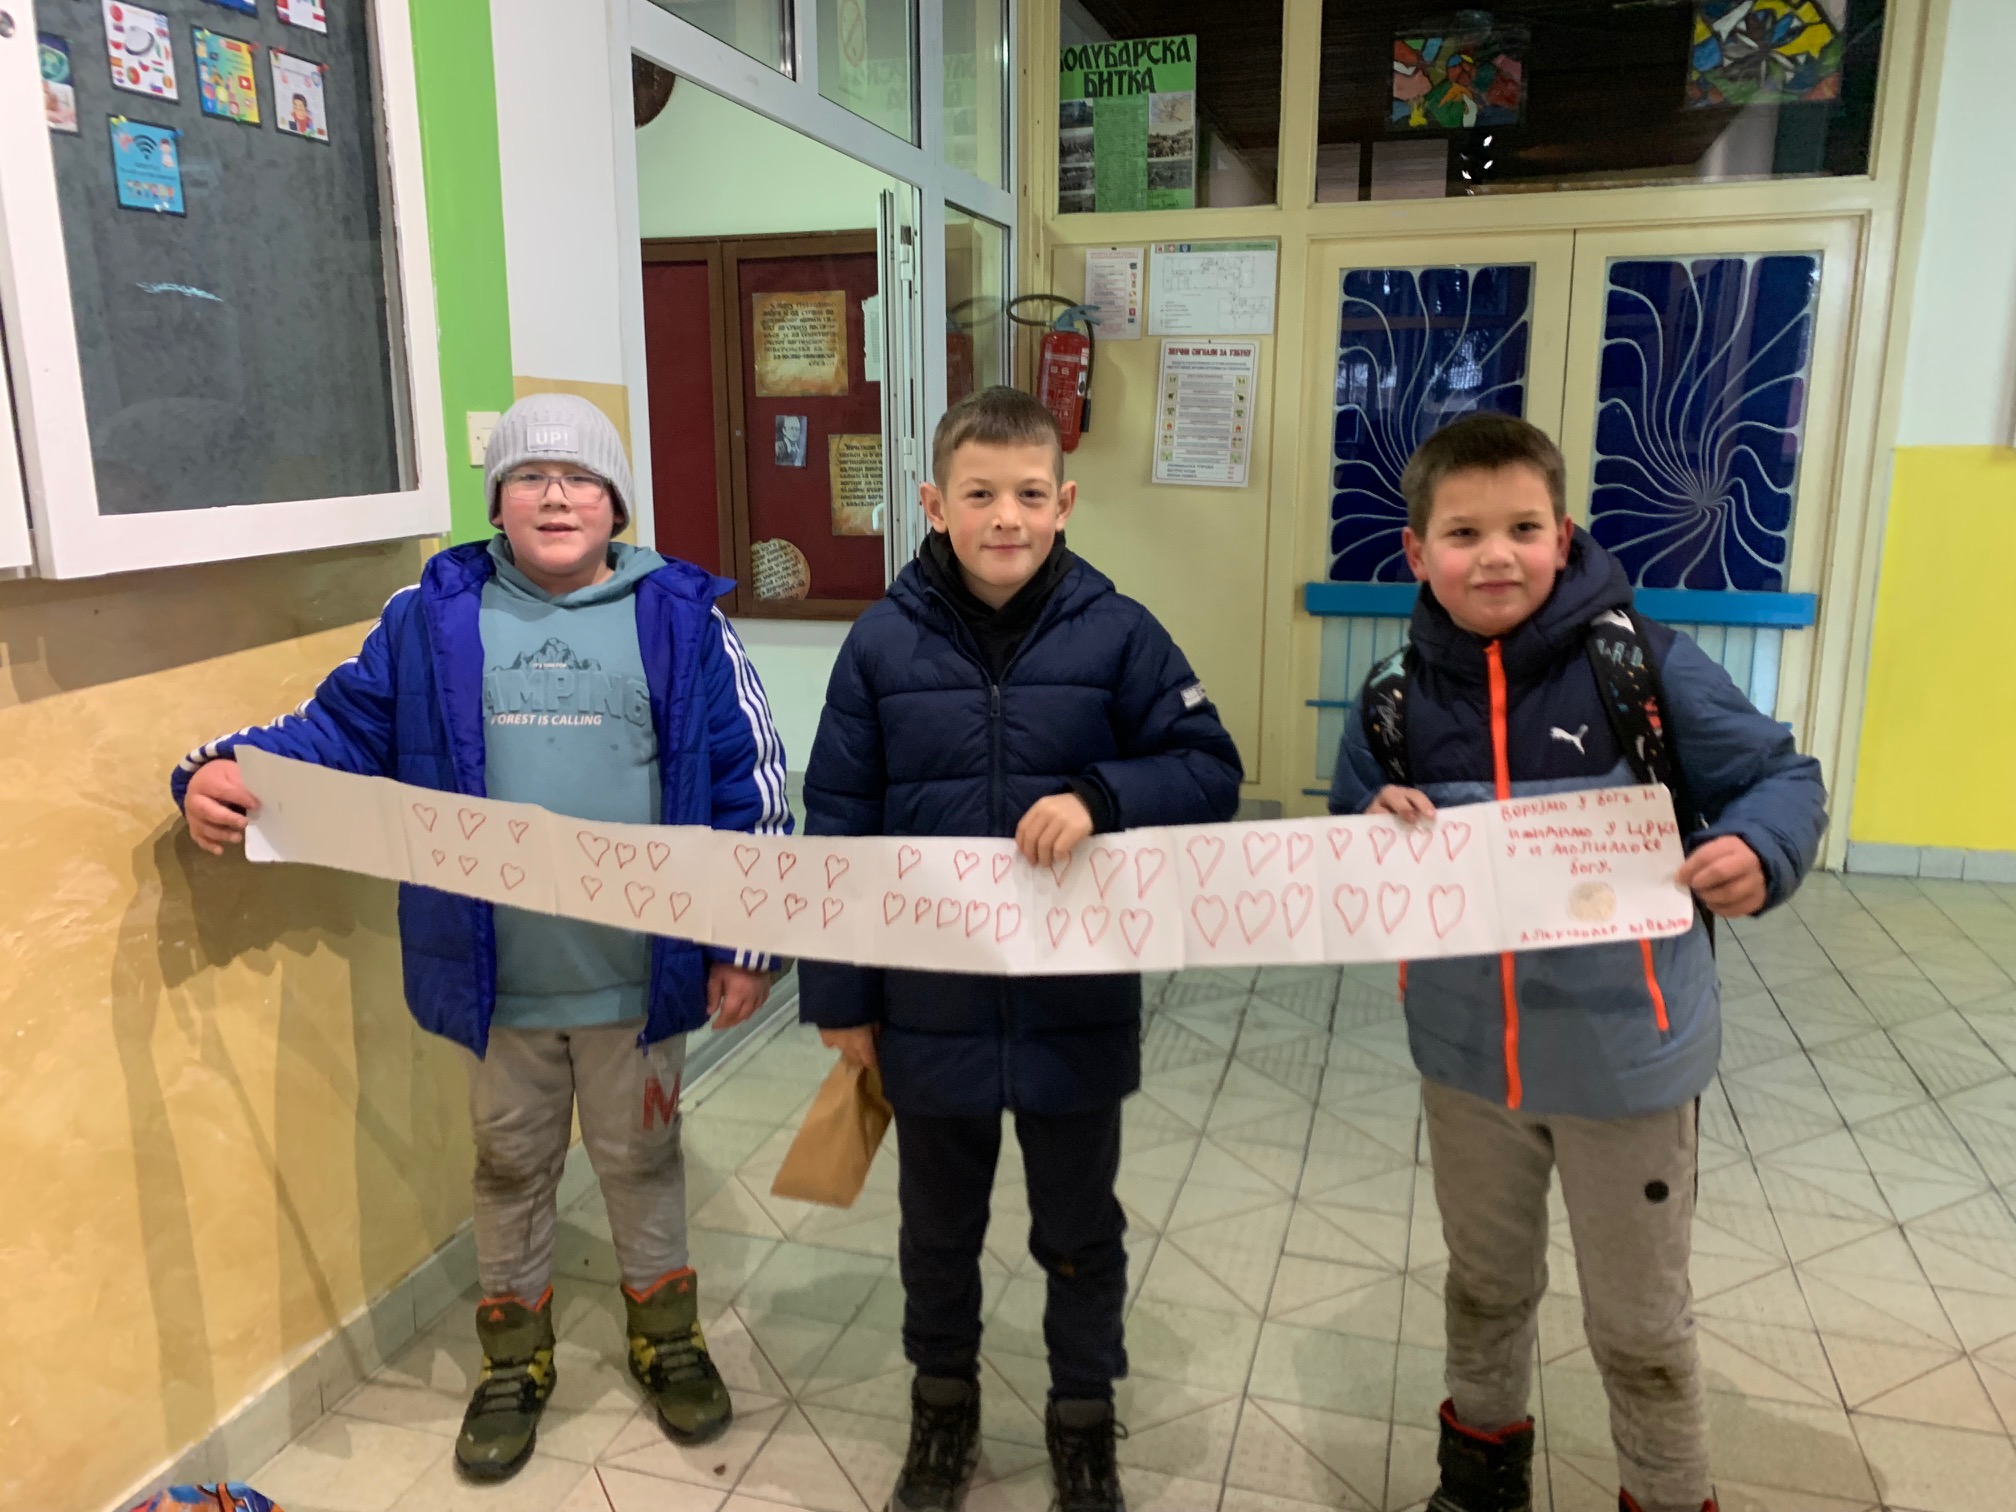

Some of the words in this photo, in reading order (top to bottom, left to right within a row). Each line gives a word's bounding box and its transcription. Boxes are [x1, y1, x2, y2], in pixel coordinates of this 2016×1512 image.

[1084, 67, 1156, 98] БИТКА
[536, 432, 569, 446] UP!
[491, 714, 535, 726] FOREST
[537, 715, 549, 726] IS
[551, 714, 602, 726] CALLING
